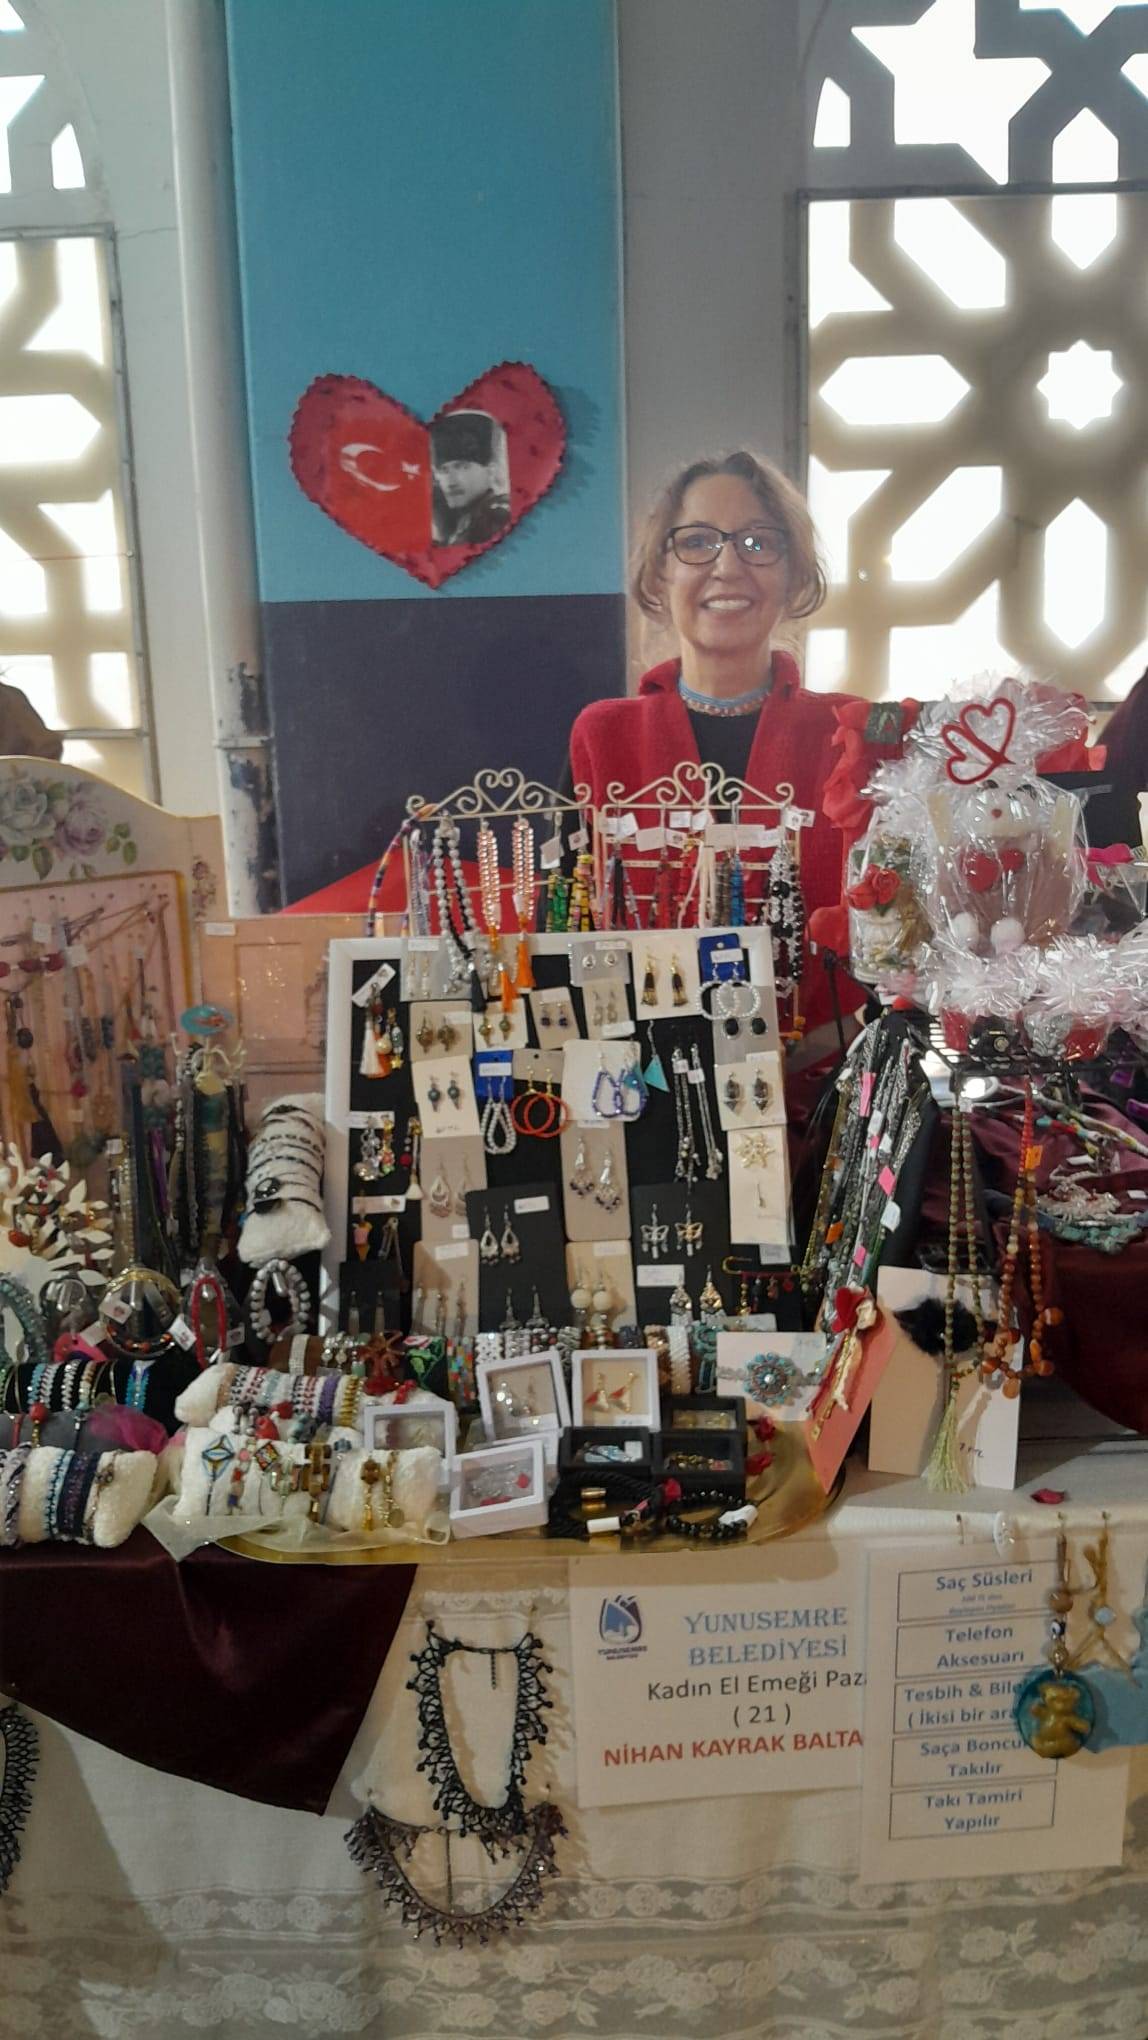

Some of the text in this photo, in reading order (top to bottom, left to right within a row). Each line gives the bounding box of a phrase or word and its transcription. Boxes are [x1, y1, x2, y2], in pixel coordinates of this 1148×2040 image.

[935, 1568, 1033, 1592] Saç Süsleri
[684, 1606, 848, 1634] YUNUSEMRE
[946, 1626, 1014, 1643] Telefon
[688, 1634, 848, 1667] BELEDİYESİ
[936, 1650, 1024, 1669] Aksesuarı
[648, 1670, 867, 1701] Kadın El Emeği Paz
[904, 1684, 963, 1702] Tesbih
[968, 1682, 983, 1698] &
[749, 1705, 776, 1724] 21
[920, 1708, 955, 1726] İkisi
[960, 1708, 984, 1723] bir
[603, 1729, 864, 1767] NİHAN KAYRAK BALTA
[920, 1738, 1027, 1758] Saça Boncu
[949, 1761, 1003, 1778] Takılır
[926, 1788, 1023, 1809] Takı Tamiri
[944, 1814, 1001, 1833] Yapılır
